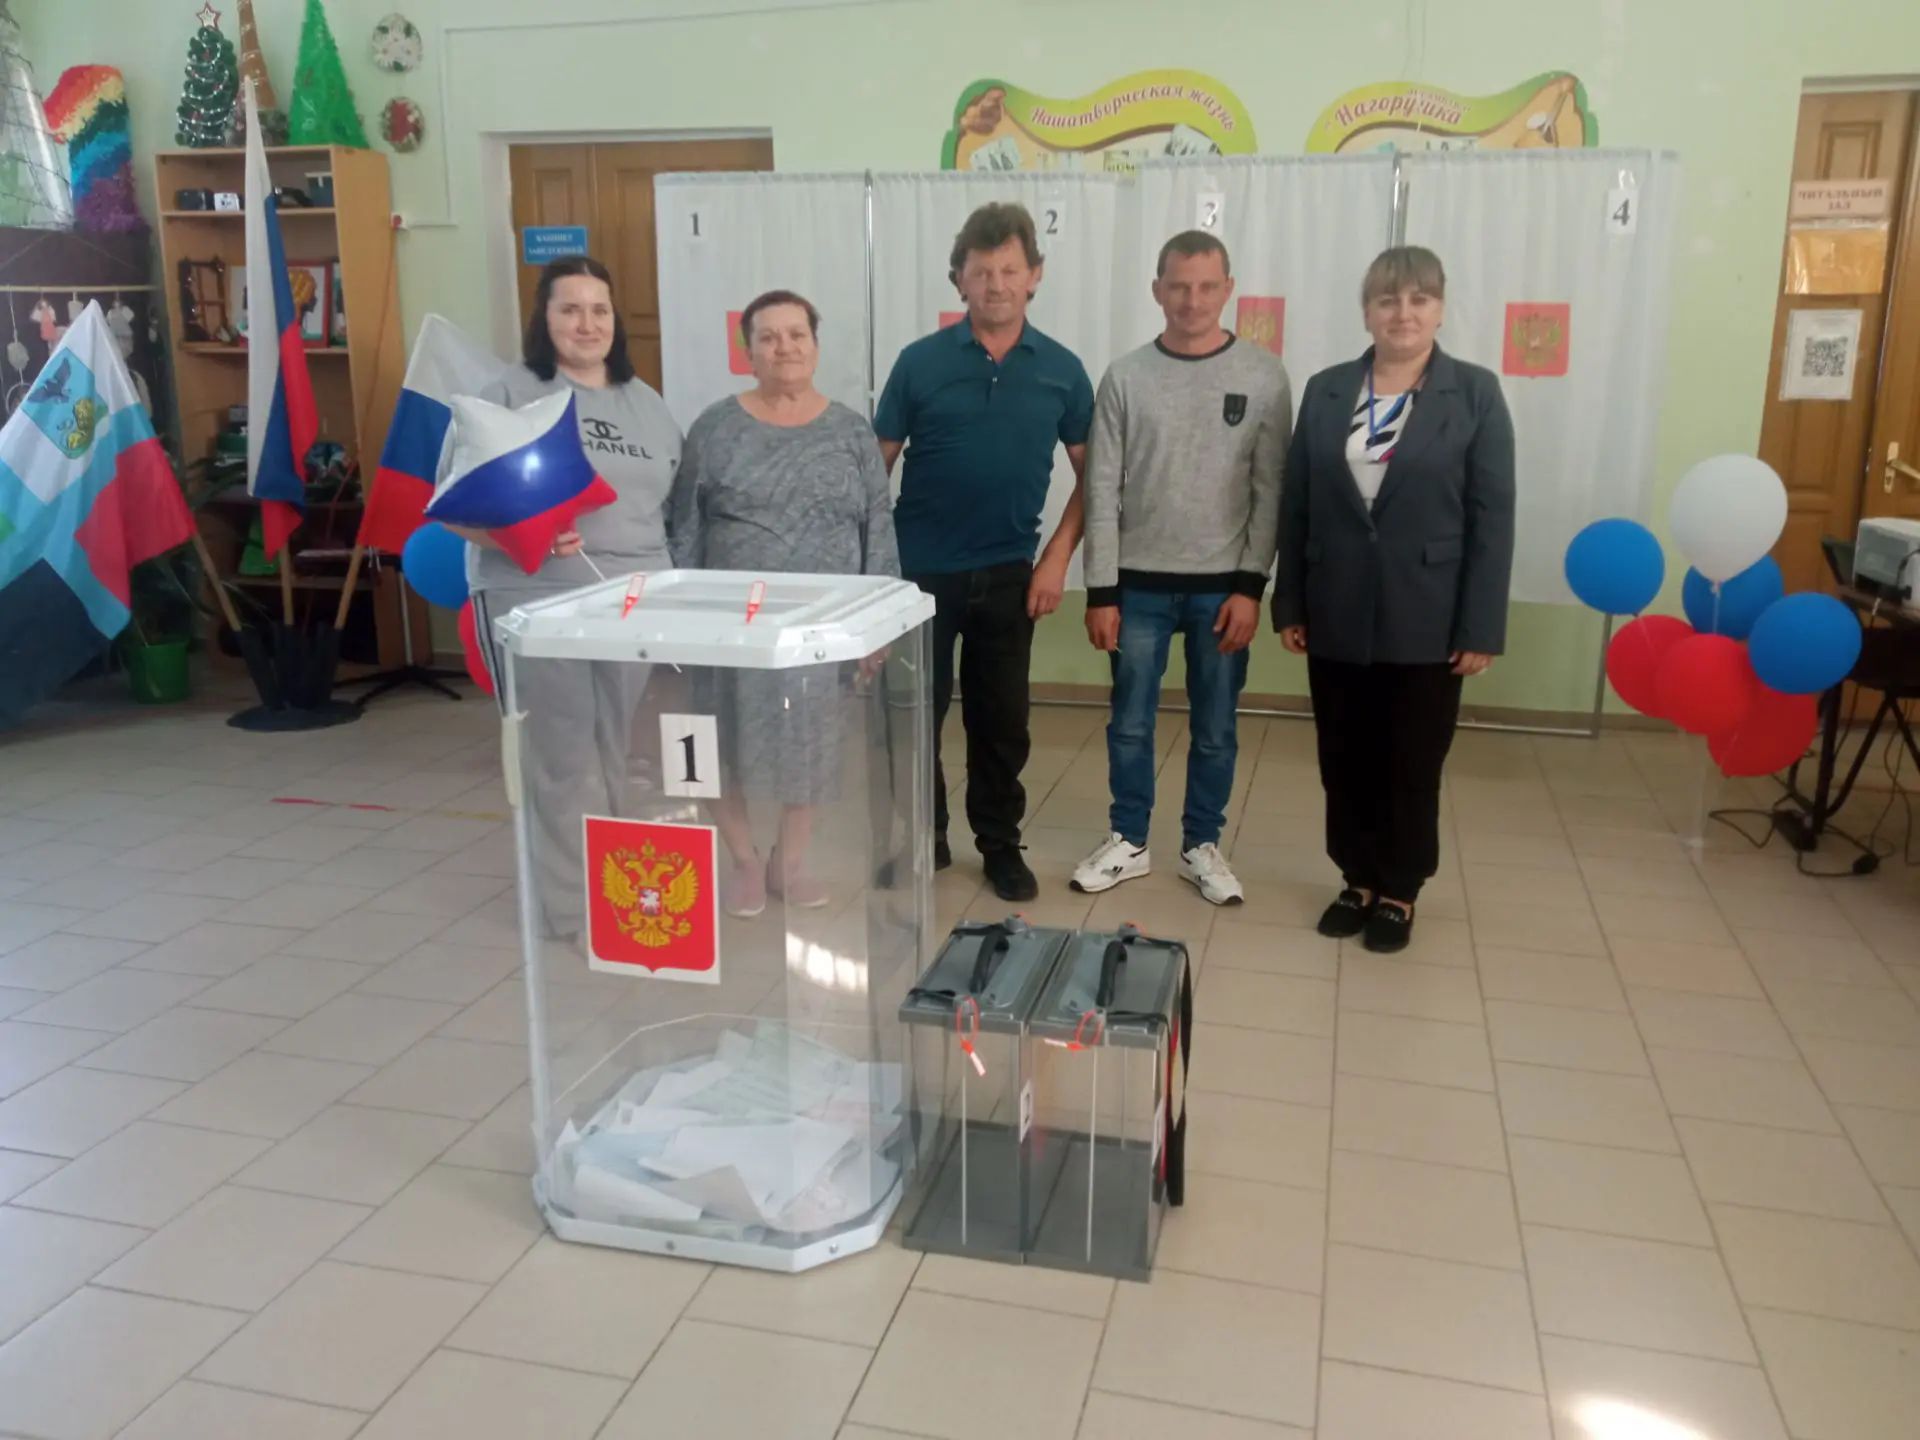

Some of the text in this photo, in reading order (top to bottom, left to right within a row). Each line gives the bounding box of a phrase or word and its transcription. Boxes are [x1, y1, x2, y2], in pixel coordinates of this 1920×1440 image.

[1188, 87, 1236, 132] жизнь
[690, 211, 701, 237] 1
[1045, 208, 1058, 234] 2
[1200, 201, 1217, 228] 3
[1612, 197, 1630, 226] 4
[583, 440, 653, 460] HANEL
[677, 733, 704, 783] 1
